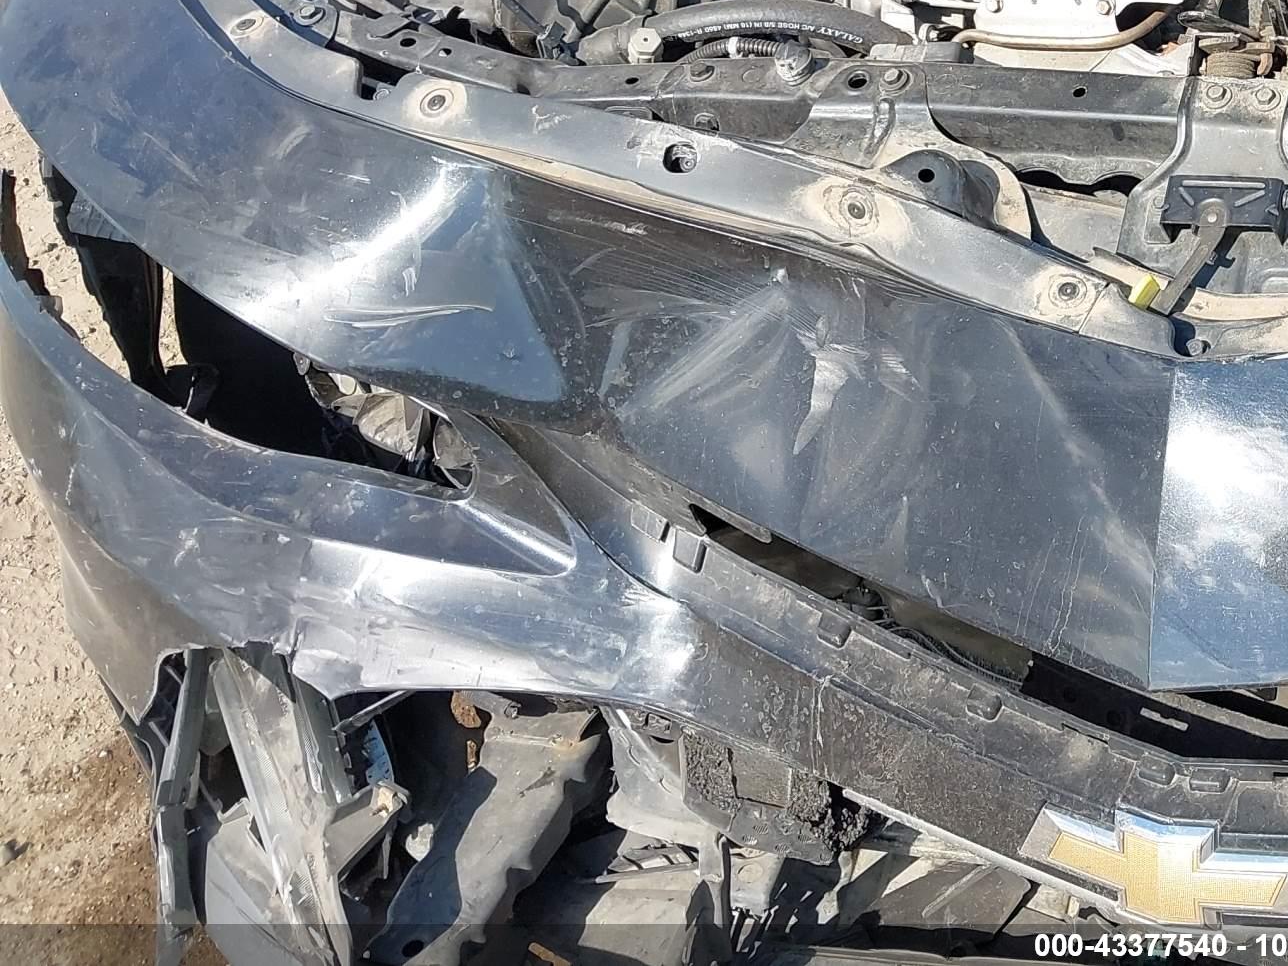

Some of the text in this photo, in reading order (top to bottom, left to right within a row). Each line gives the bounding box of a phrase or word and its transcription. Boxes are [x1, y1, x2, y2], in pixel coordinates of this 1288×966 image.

[778, 22, 800, 30] HOSE
[801, 24, 816, 32] A/C
[816, 26, 863, 44] GALAXY
